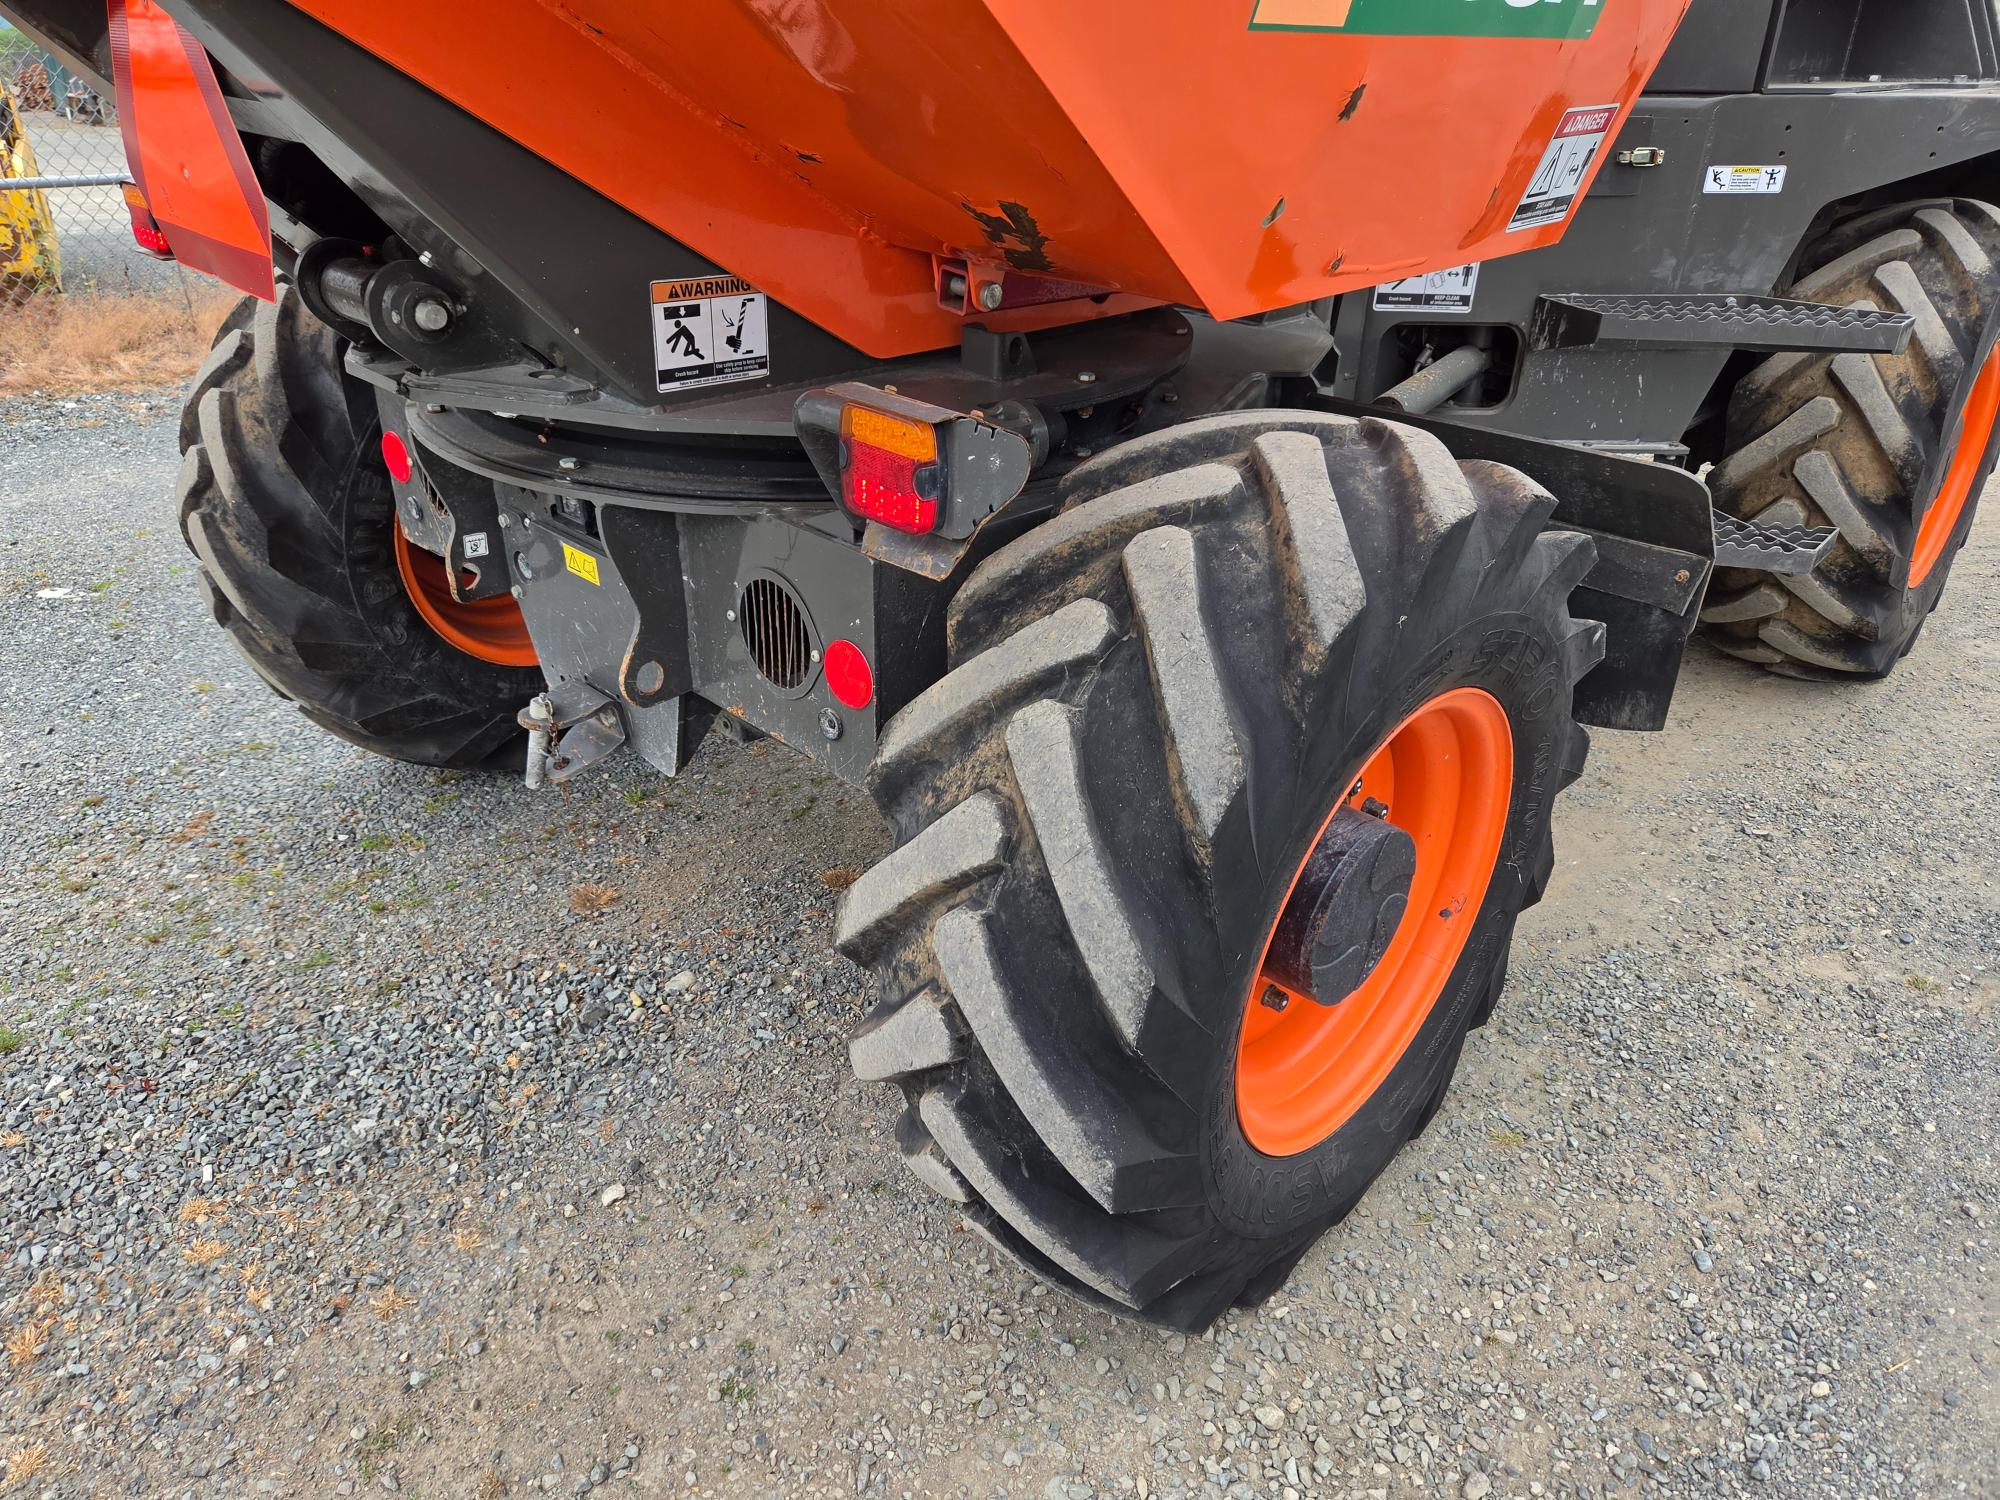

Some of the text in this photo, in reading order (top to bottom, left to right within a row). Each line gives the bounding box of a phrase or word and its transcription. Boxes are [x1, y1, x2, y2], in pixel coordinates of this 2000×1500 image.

[1571, 113, 1608, 132] DANGER
[679, 279, 751, 298] WARNING
[675, 370, 686, 378] Crush
